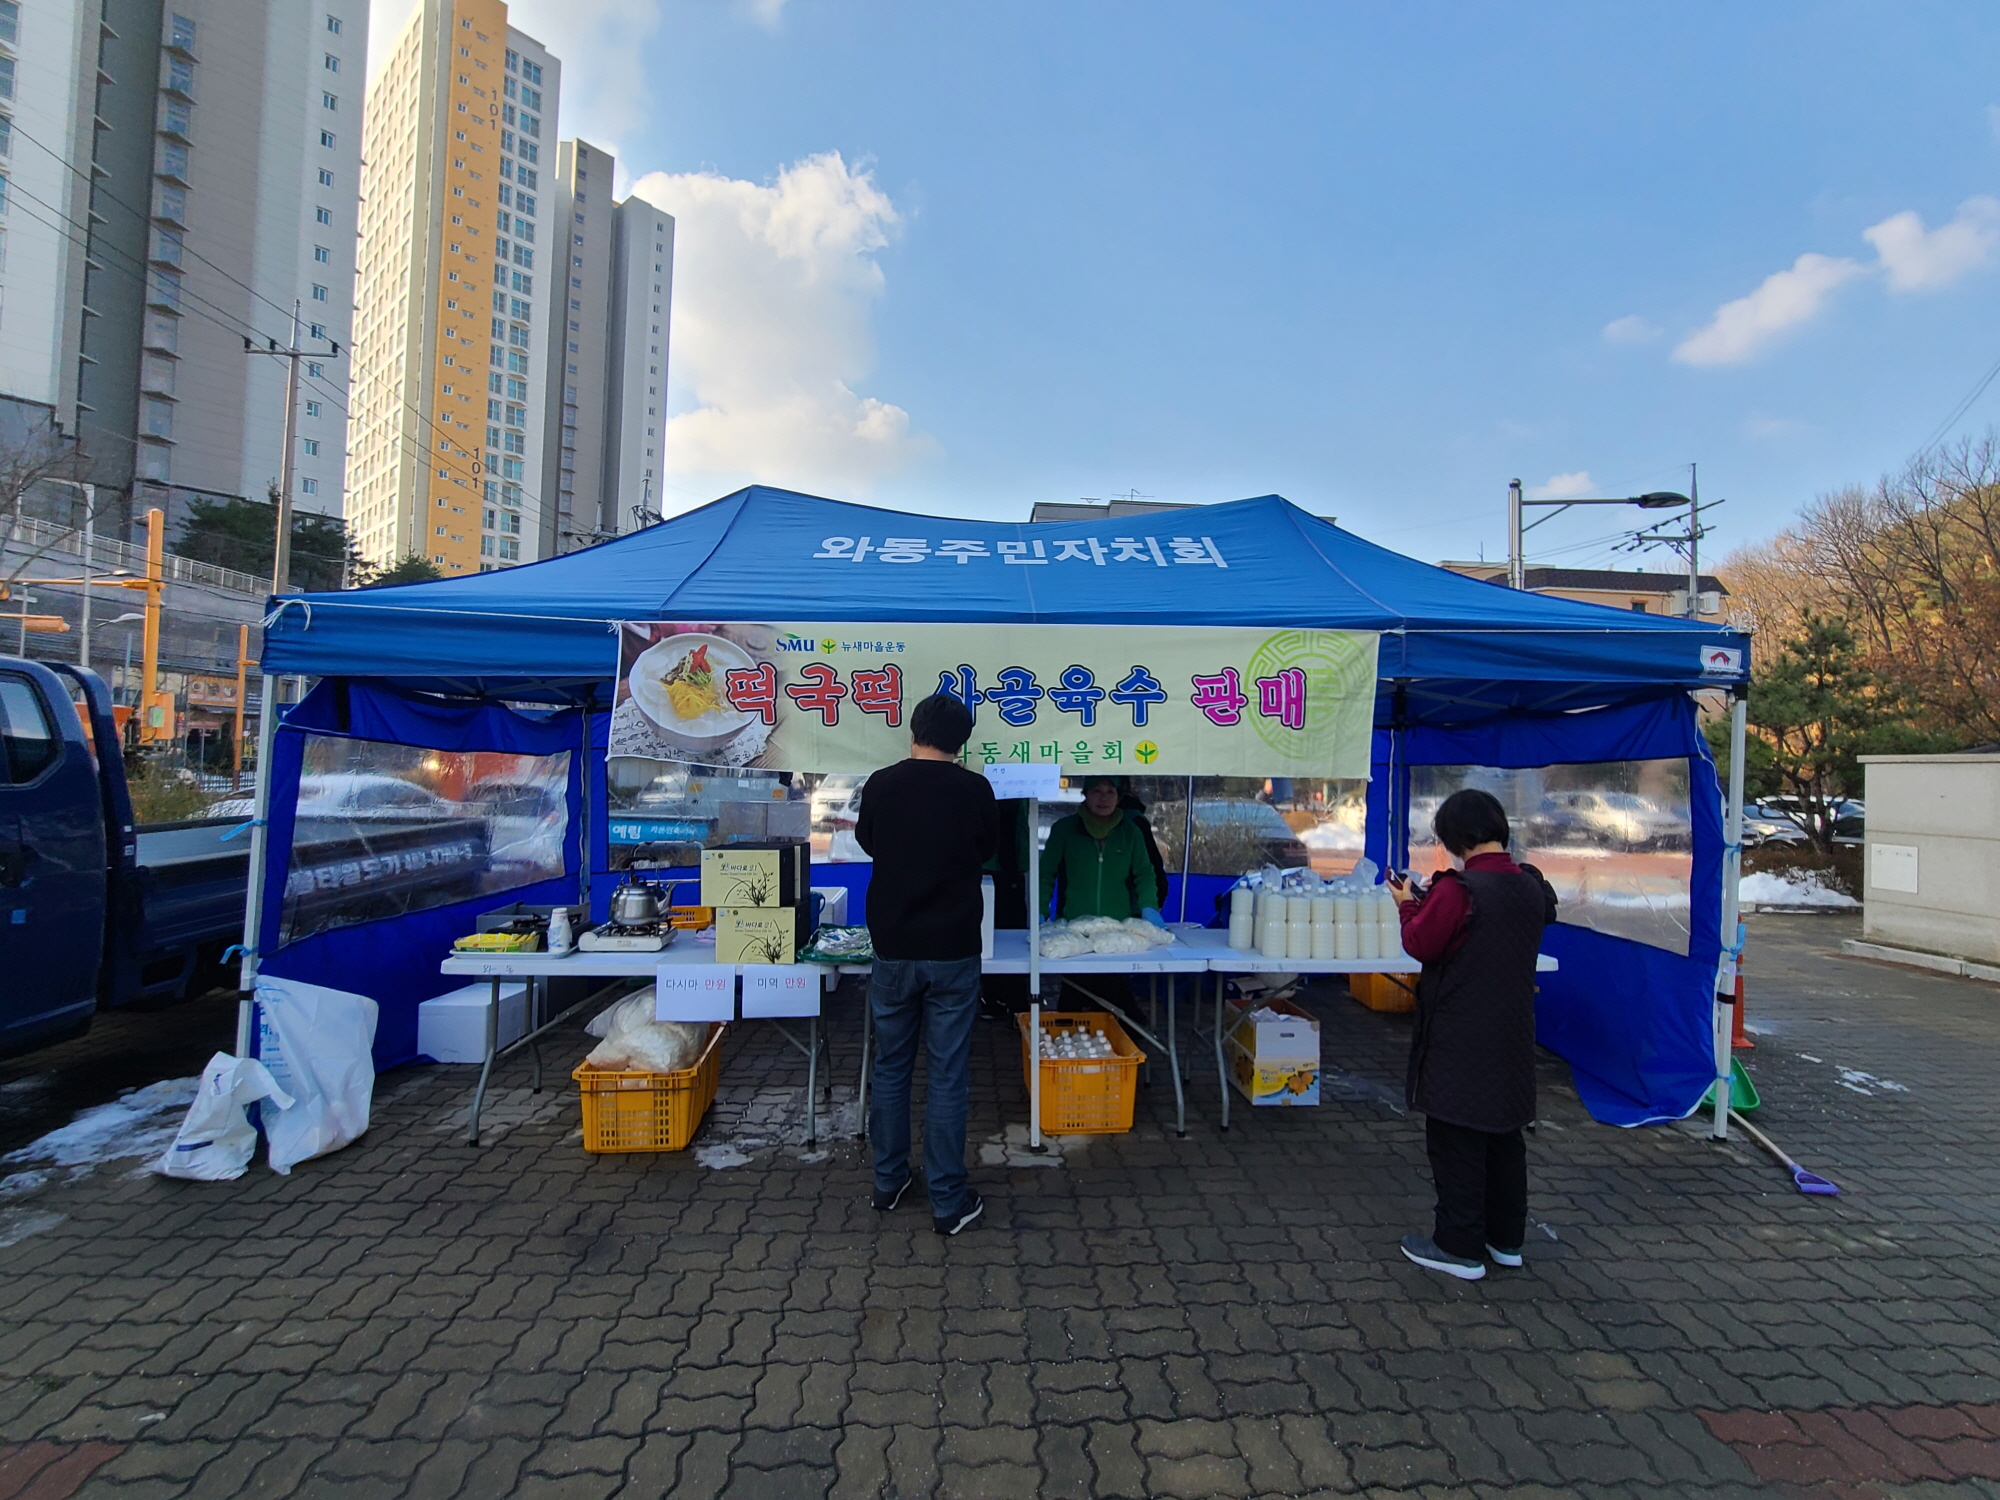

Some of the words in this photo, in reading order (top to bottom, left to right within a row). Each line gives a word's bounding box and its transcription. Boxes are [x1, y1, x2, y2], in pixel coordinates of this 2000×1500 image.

[489, 89, 499, 131] 101
[471, 447, 481, 489] 101
[813, 536, 1228, 568] 와동주민자치회
[776, 637, 815, 652] SMU
[841, 641, 906, 653] 뉴새마을운동
[725, 662, 903, 727] 떡국떡
[935, 664, 1168, 727] 사골육수
[1191, 666, 1307, 730] 판매
[665, 978, 698, 991] 다시마
[704, 979, 726, 990] 만원
[757, 977, 780, 989] 미역
[785, 976, 807, 989] 만원
